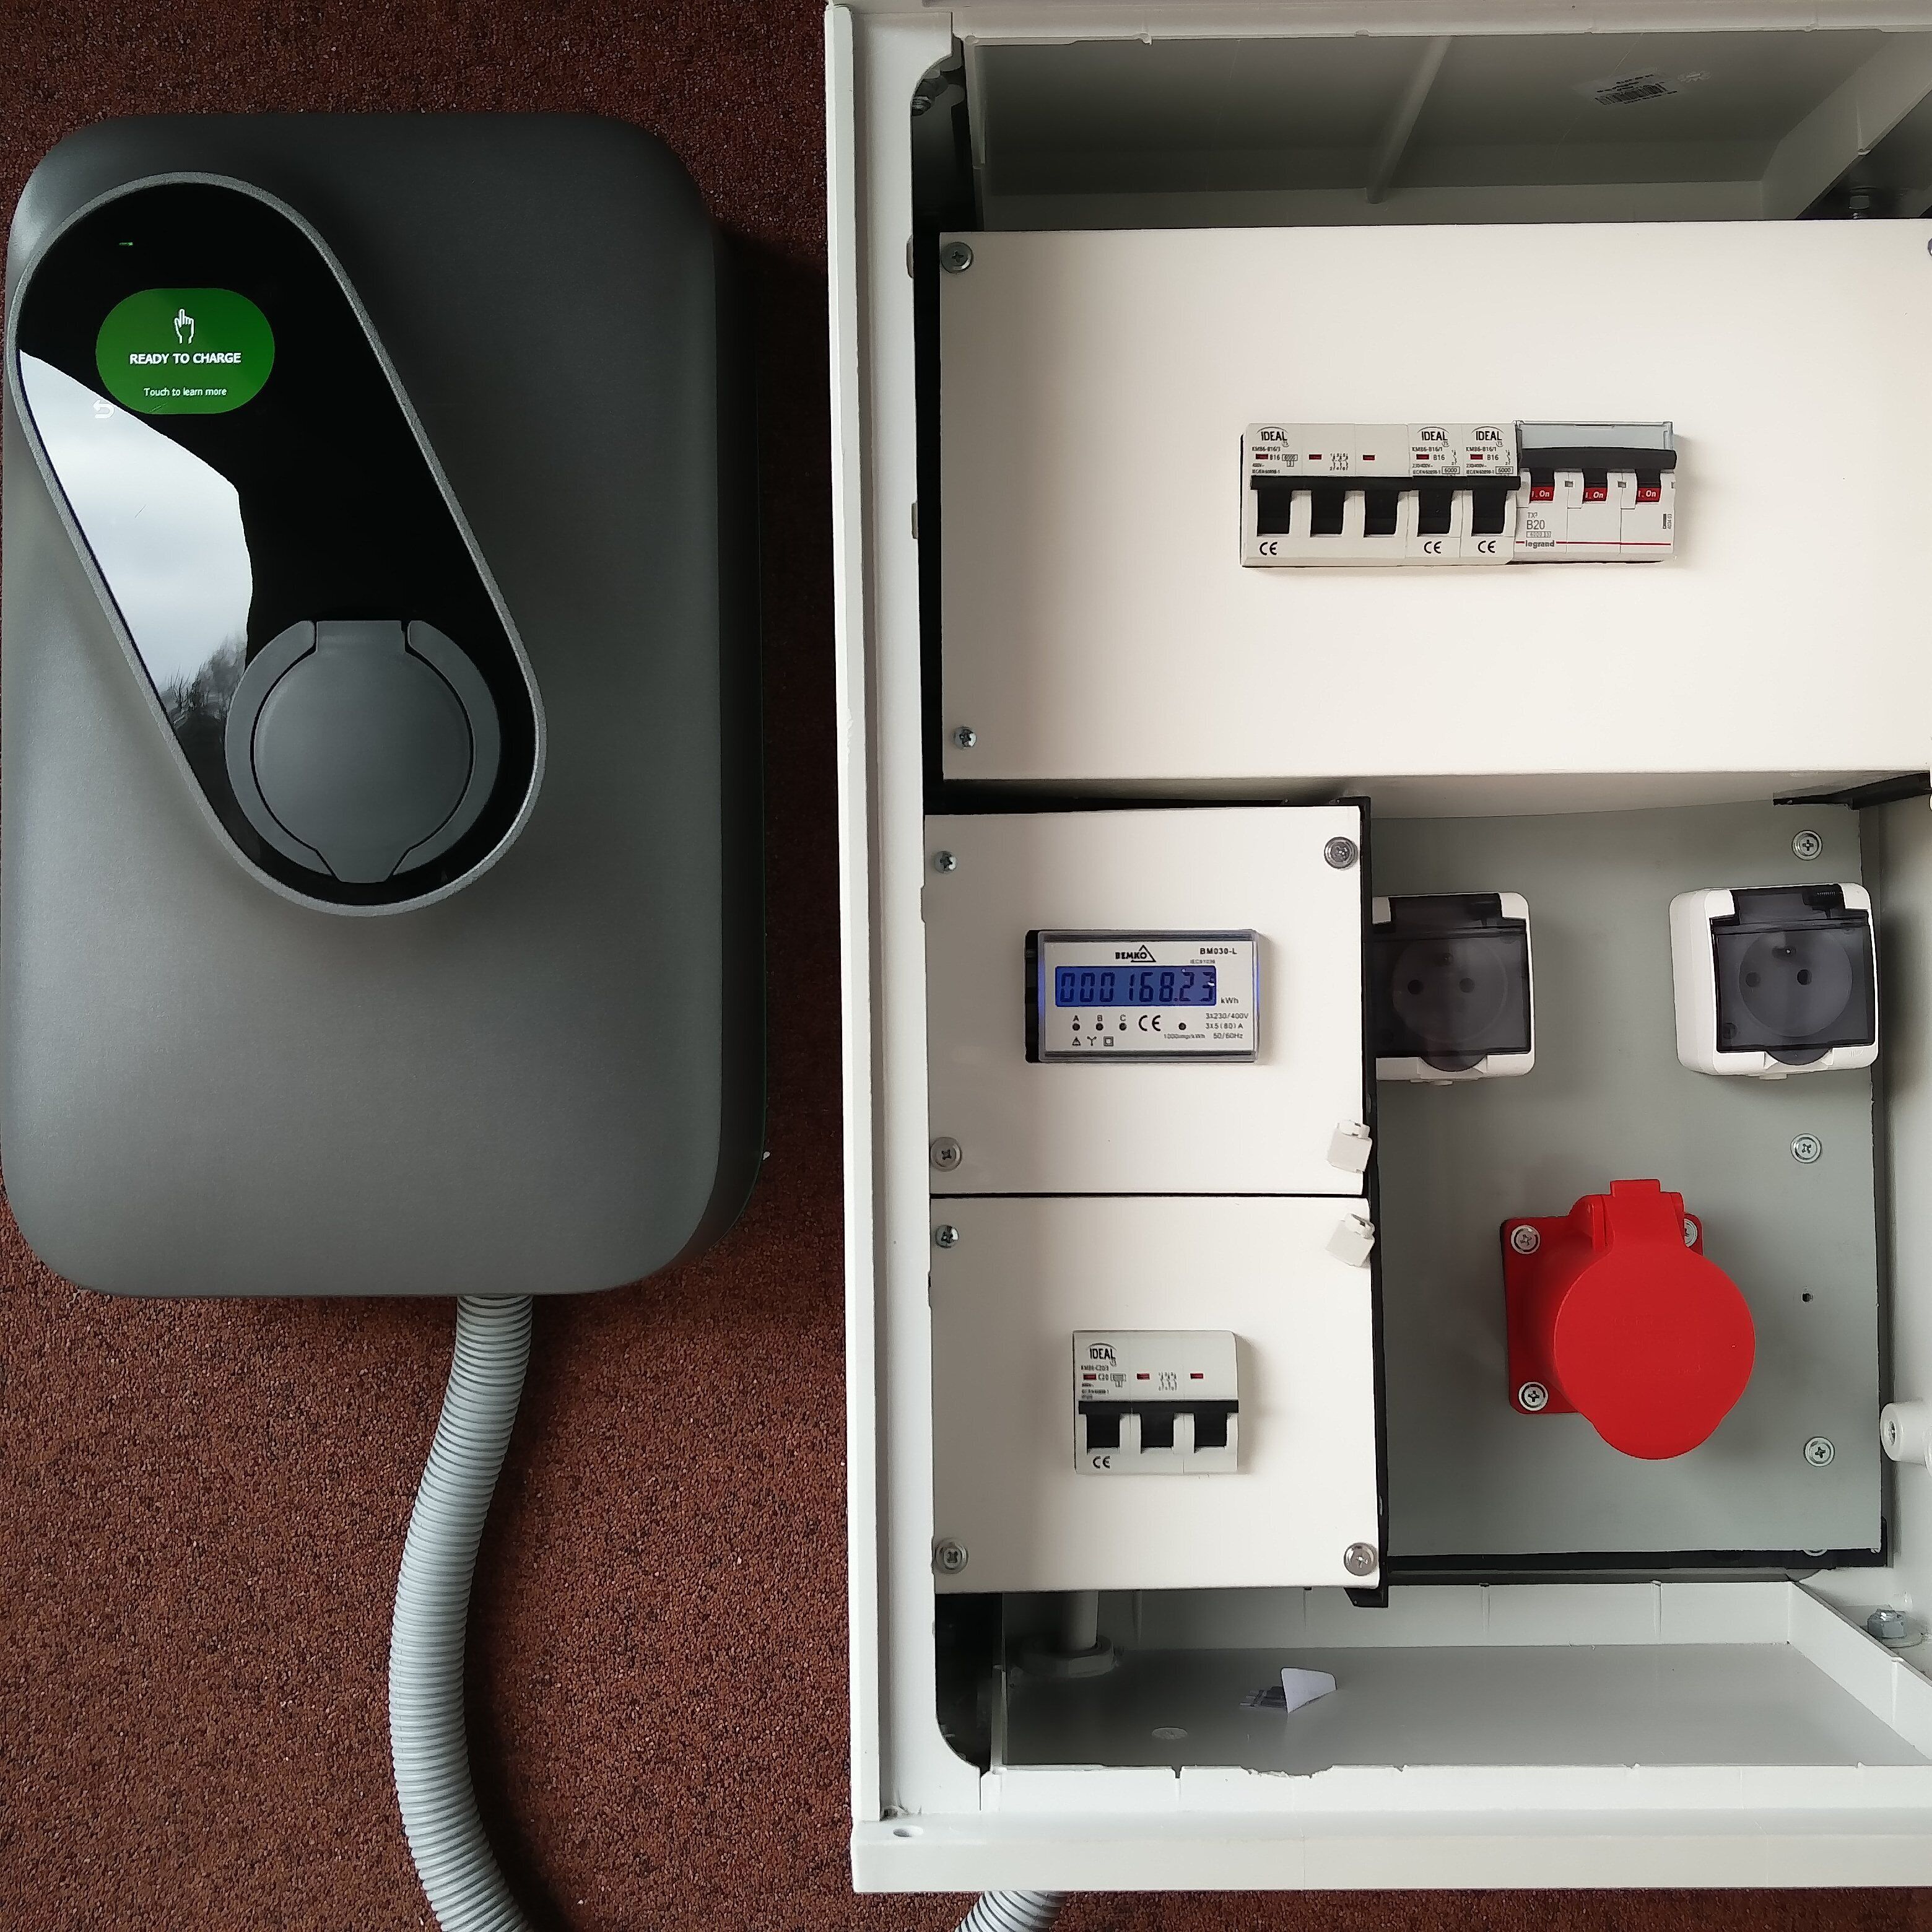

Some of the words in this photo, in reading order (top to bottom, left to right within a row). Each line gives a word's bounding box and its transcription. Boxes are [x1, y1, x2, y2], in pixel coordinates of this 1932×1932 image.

[129, 354, 170, 364] READY
[173, 354, 189, 363] TO
[193, 352, 242, 363] CHARGE
[144, 388, 170, 396] Touch
[172, 388, 181, 396] to
[183, 387, 202, 396] learn
[1261, 431, 1288, 441] IDEAL
[1422, 431, 1448, 441] IDEAL
[1476, 430, 1503, 441] IDEAL
[1526, 520, 1545, 529] B20
[1525, 540, 1554, 549] legrand
[1090, 1348, 1115, 1359] IDEAL
